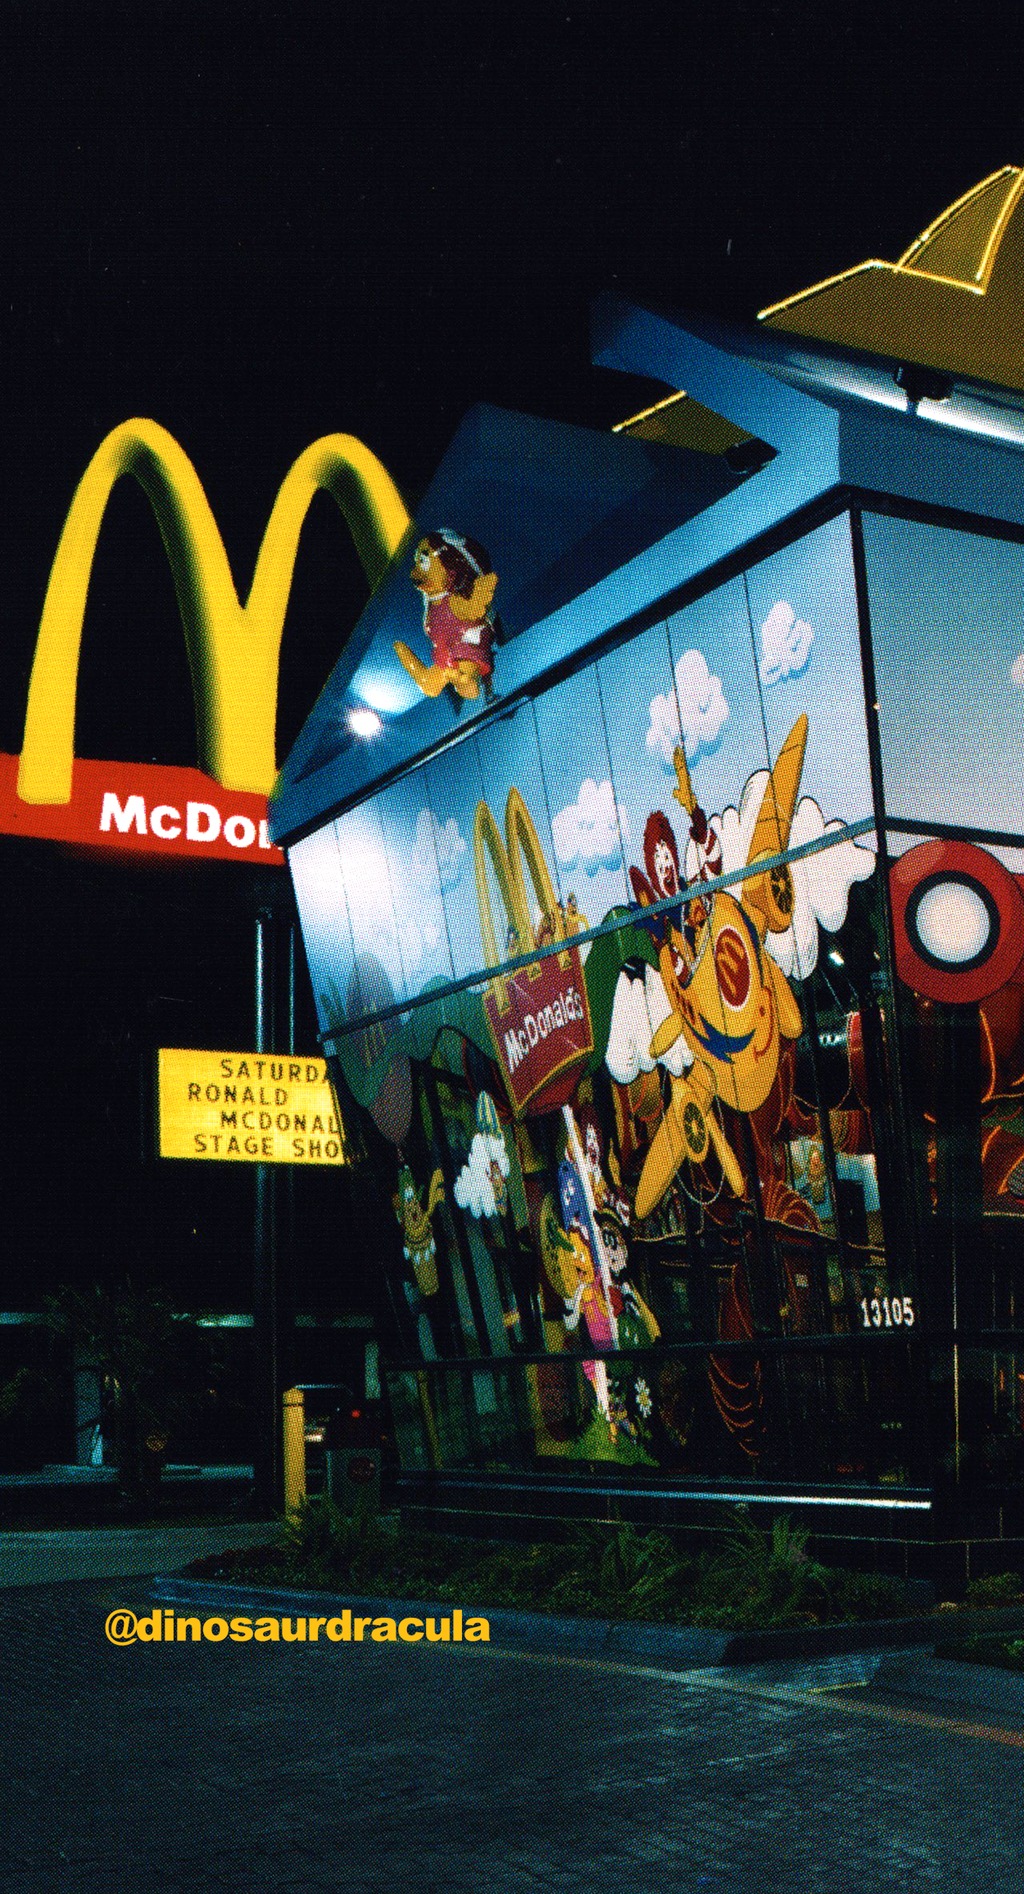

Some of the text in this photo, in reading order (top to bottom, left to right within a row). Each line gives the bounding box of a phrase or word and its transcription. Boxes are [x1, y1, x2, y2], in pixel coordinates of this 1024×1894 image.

[220, 1058, 329, 1084] SATURD
[188, 1082, 289, 1106] RONALD
[220, 1110, 339, 1135] MCDONAL
[194, 1133, 339, 1159] STAGE SHO
[861, 1297, 915, 1328] 13105
